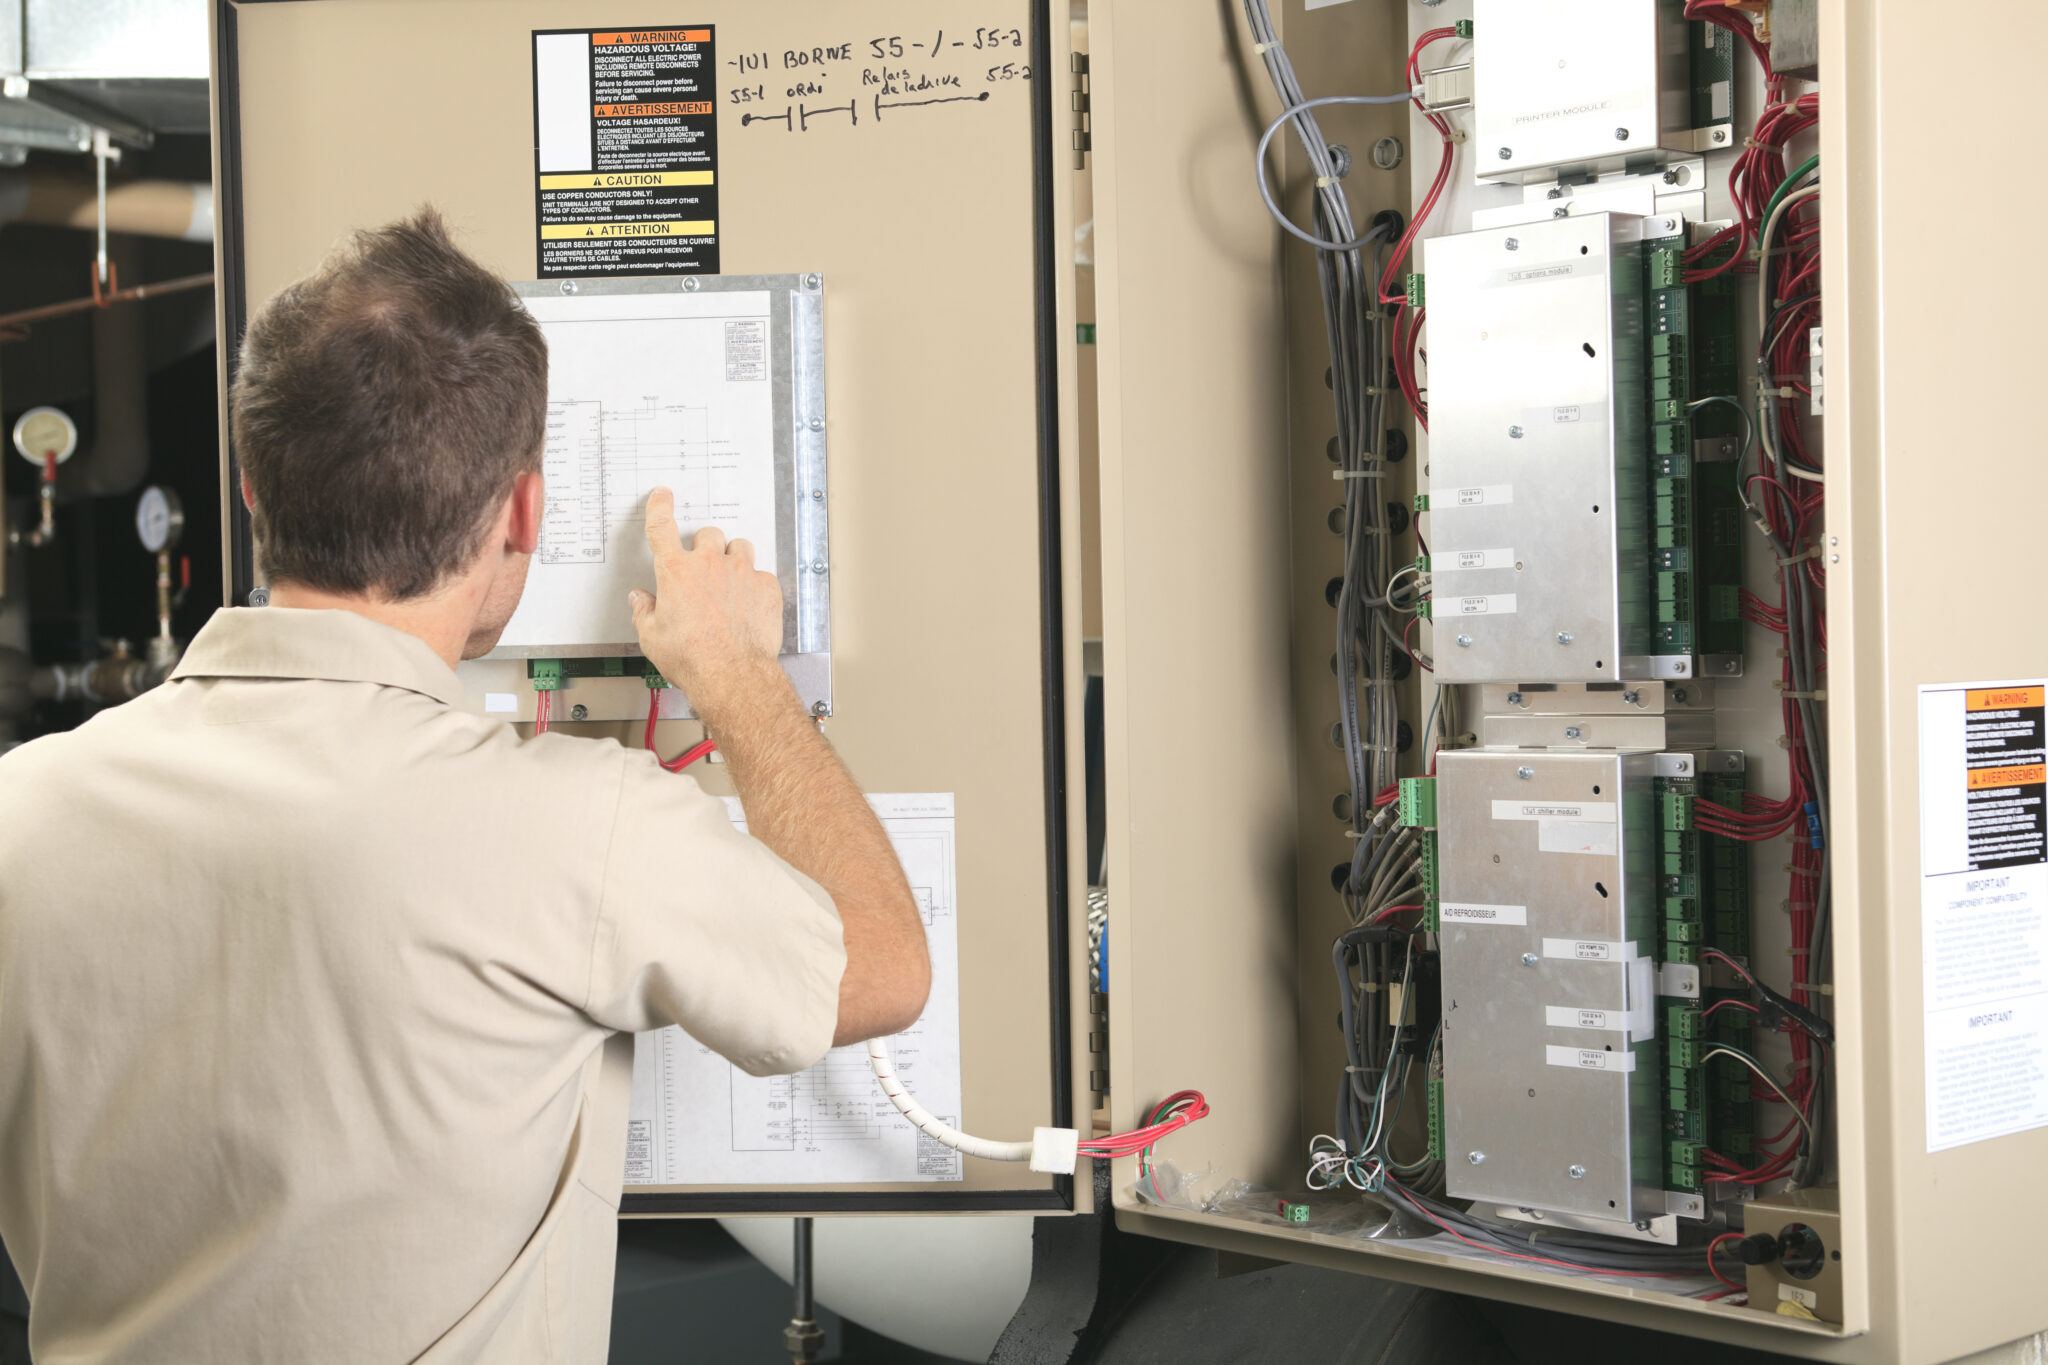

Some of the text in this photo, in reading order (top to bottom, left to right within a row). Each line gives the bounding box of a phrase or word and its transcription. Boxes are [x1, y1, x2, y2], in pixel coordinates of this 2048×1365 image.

[630, 31, 687, 43] WARNING
[594, 45, 650, 54] HAZARDOUS
[647, 54, 677, 62] ELECTRIC
[783, 43, 852, 69] BORNE
[595, 61, 699, 71] INCLUDING REMOTE DISCONNECTS
[655, 79, 673, 87] power
[596, 88, 621, 96] servicing
[672, 85, 698, 94] personal
[596, 95, 612, 103] injury
[612, 102, 710, 116] AVERTISSEMENT
[1563, 101, 1608, 115] MODULE
[606, 174, 662, 186] CAUTION
[584, 191, 630, 199] CONDUCTORS
[613, 214, 634, 222] damage
[600, 224, 670, 236] ATTENTION
[627, 239, 677, 247] CONDUCTEURS
[629, 263, 663, 271] endommager
[1992, 692, 2028, 705] WARNING
[1966, 876, 2010, 893] IMPORTANT
[1969, 1011, 2013, 1029] IMPORTANT
